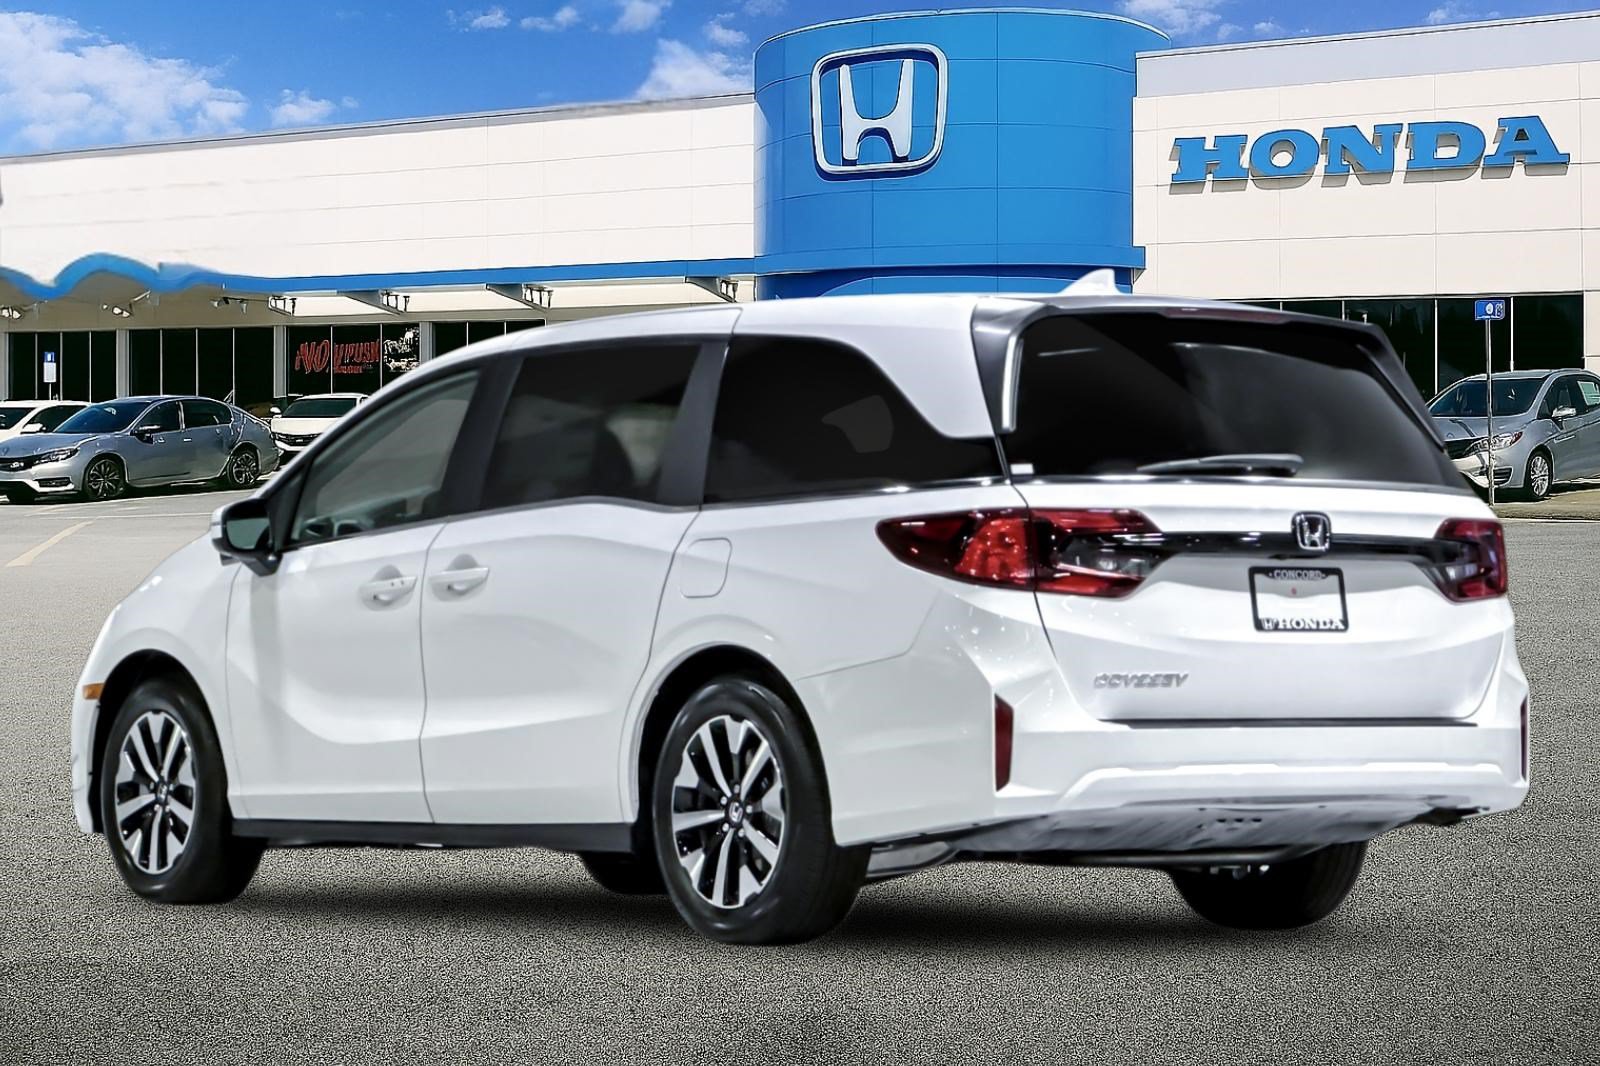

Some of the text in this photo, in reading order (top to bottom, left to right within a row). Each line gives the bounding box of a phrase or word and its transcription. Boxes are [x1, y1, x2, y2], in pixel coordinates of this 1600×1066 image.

[1171, 115, 1570, 185] HONDA
[1273, 569, 1322, 579] CONCORD
[1277, 618, 1346, 630] HONDA
[1093, 672, 1189, 689] ODYSSEY
